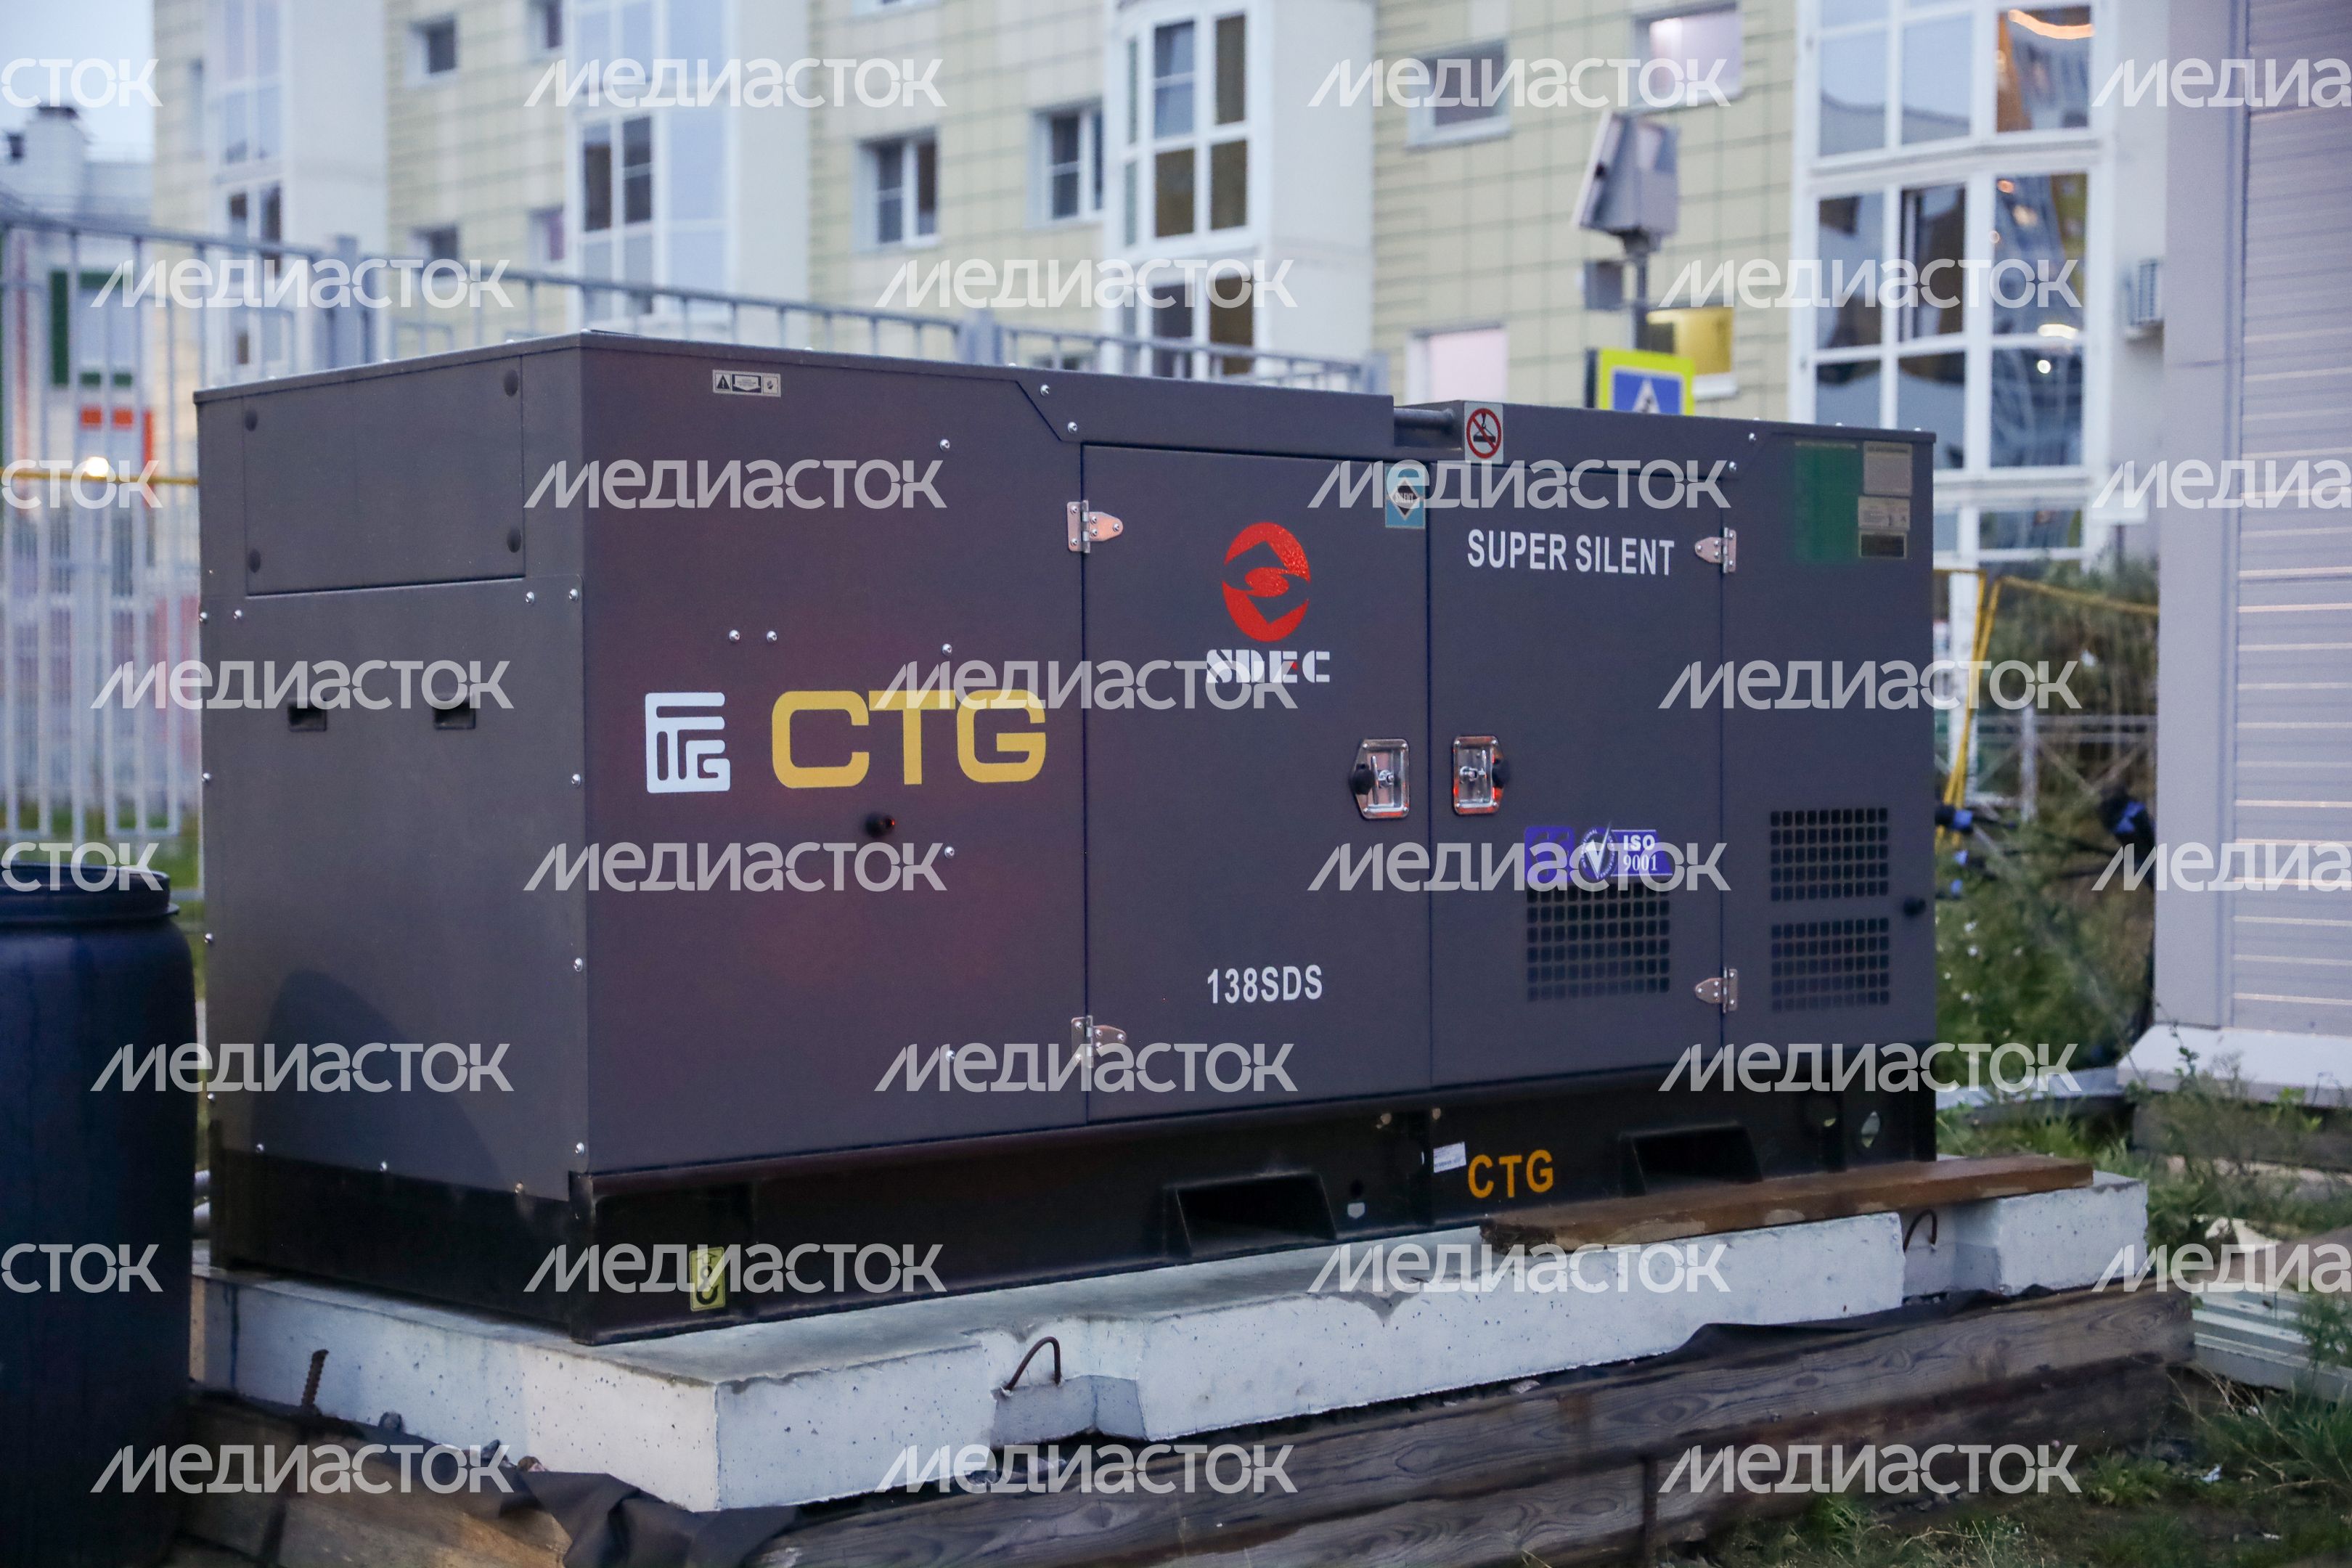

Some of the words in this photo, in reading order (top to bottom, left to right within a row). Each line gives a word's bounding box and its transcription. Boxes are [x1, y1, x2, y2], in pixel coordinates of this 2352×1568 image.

[1467, 528, 1567, 571] SUPER
[1575, 534, 1675, 576] SILENT
[771, 689, 1047, 789] CTG
[1623, 834, 1655, 852] ISO
[1623, 854, 1658, 872] 9001
[1207, 964, 1323, 1004] 138SDS
[1468, 1149, 1554, 1199] CTG
